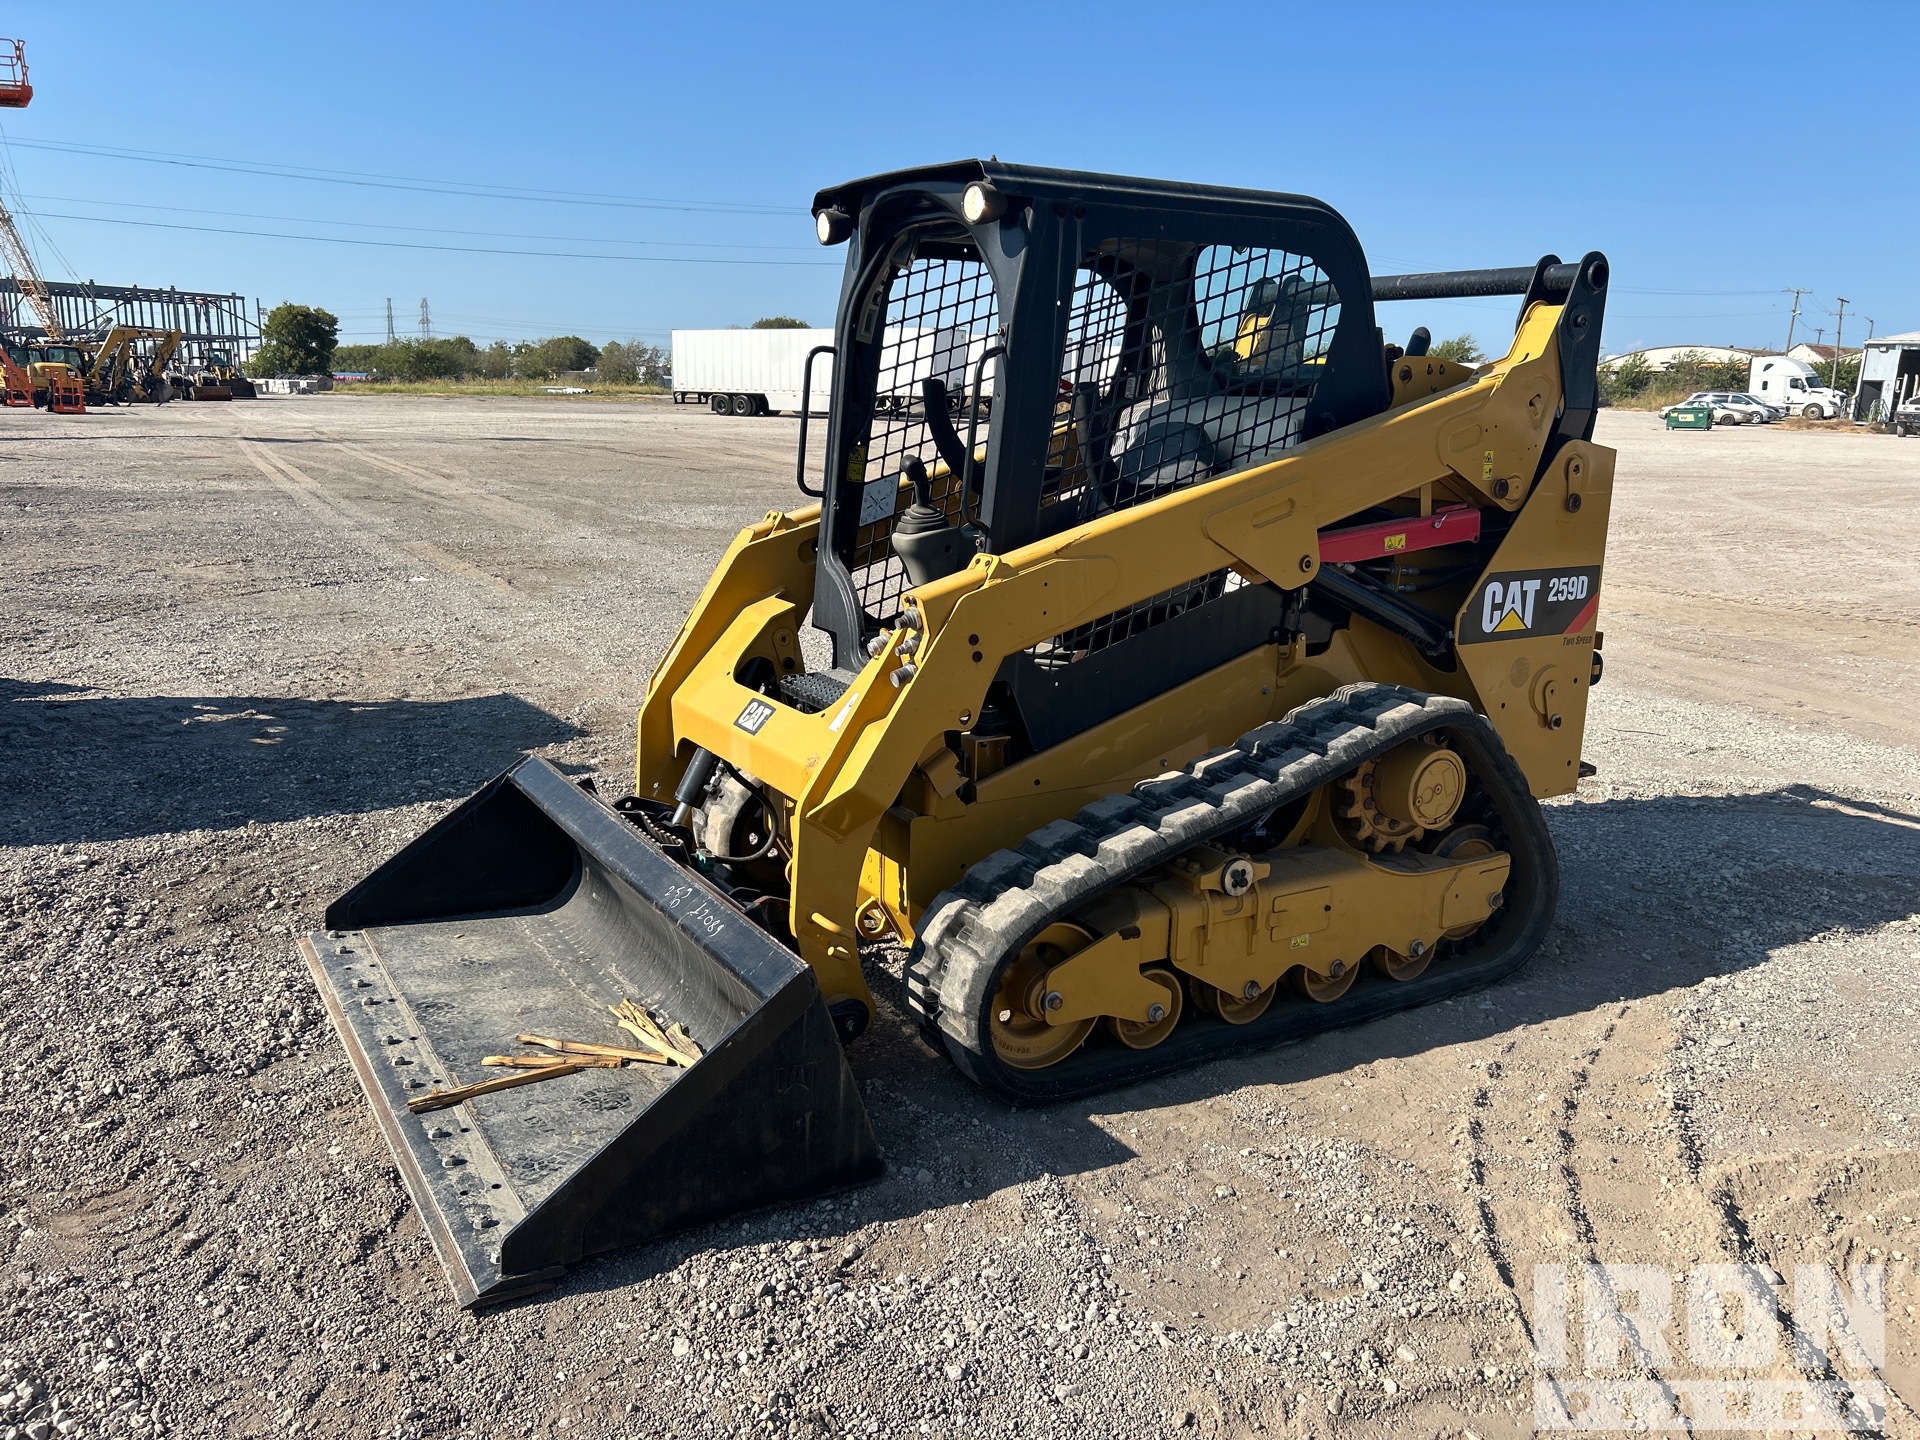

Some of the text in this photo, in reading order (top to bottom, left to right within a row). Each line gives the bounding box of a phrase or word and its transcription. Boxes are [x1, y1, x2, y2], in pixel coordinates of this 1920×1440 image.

[1547, 575, 1589, 602] 259D
[1481, 579, 1541, 633] CAT
[737, 701, 772, 732] CAT
